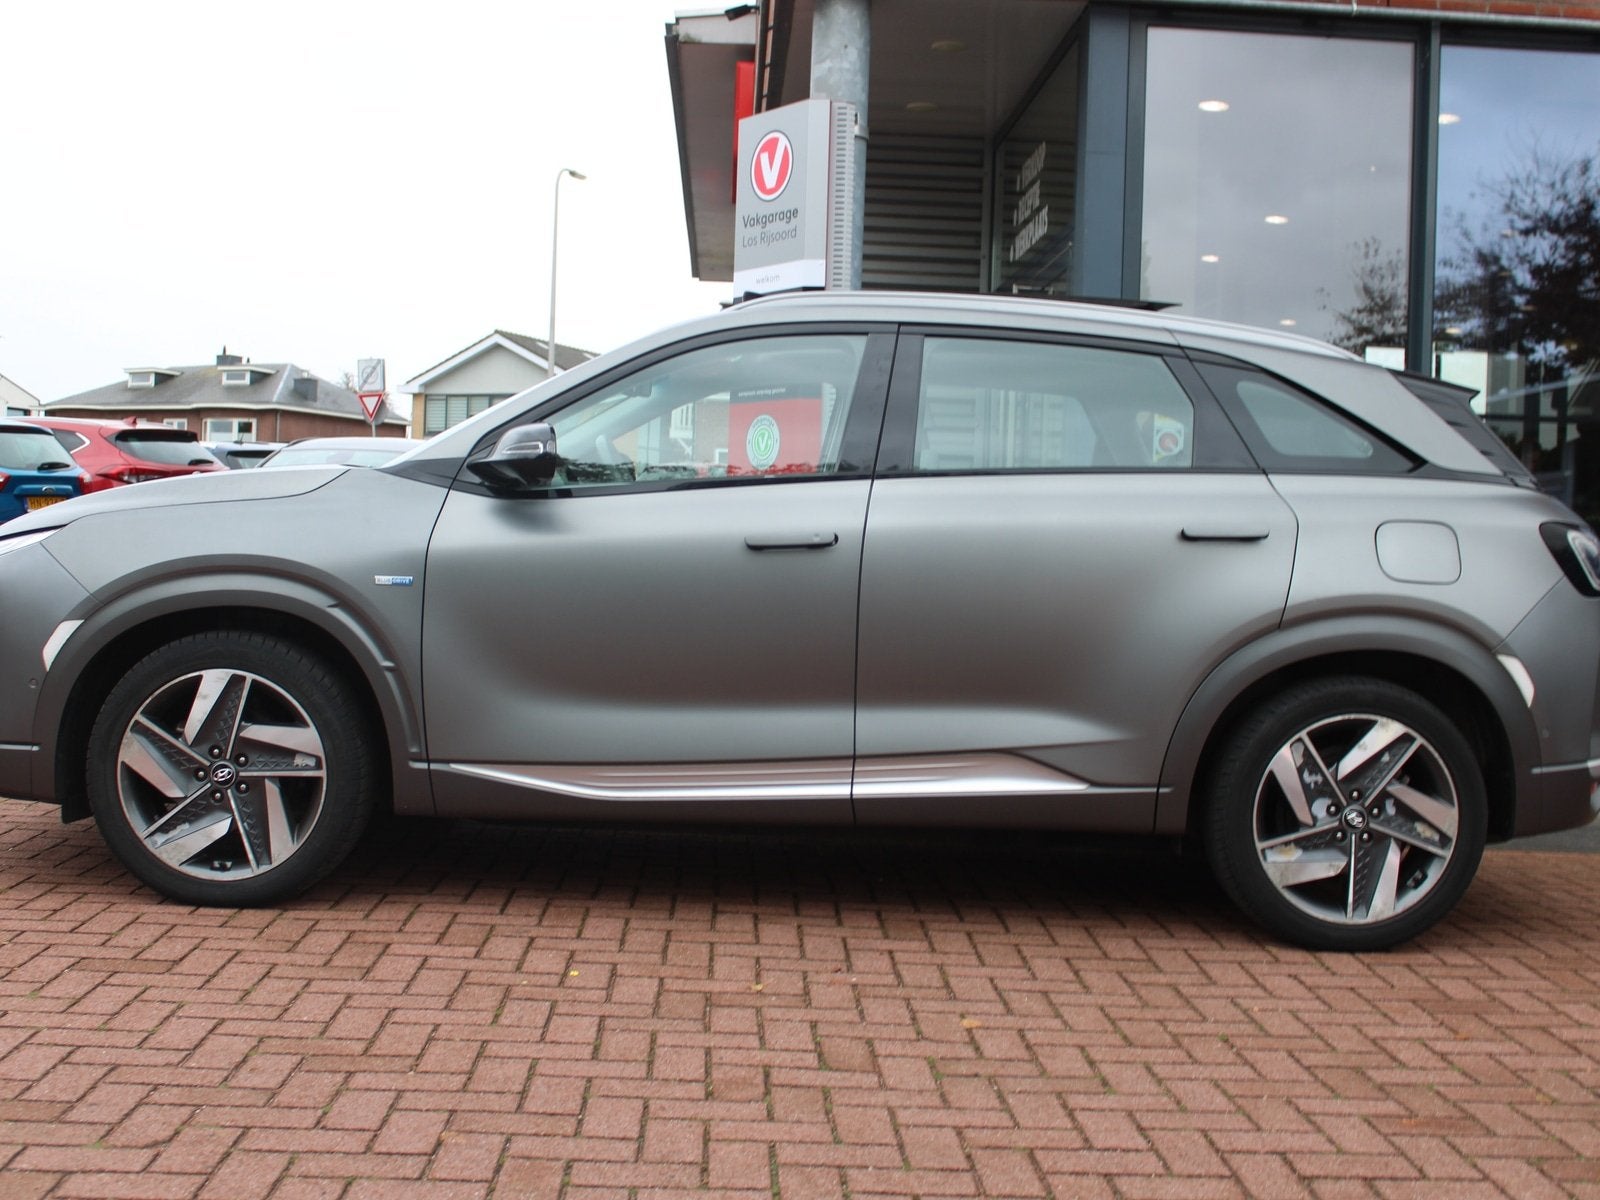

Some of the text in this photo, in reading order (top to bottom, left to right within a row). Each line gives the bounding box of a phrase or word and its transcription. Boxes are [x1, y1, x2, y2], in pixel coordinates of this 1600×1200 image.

[742, 207, 799, 230] Vakgarage
[742, 225, 798, 248] Los Rijsoord
[755, 274, 781, 285] welkom
